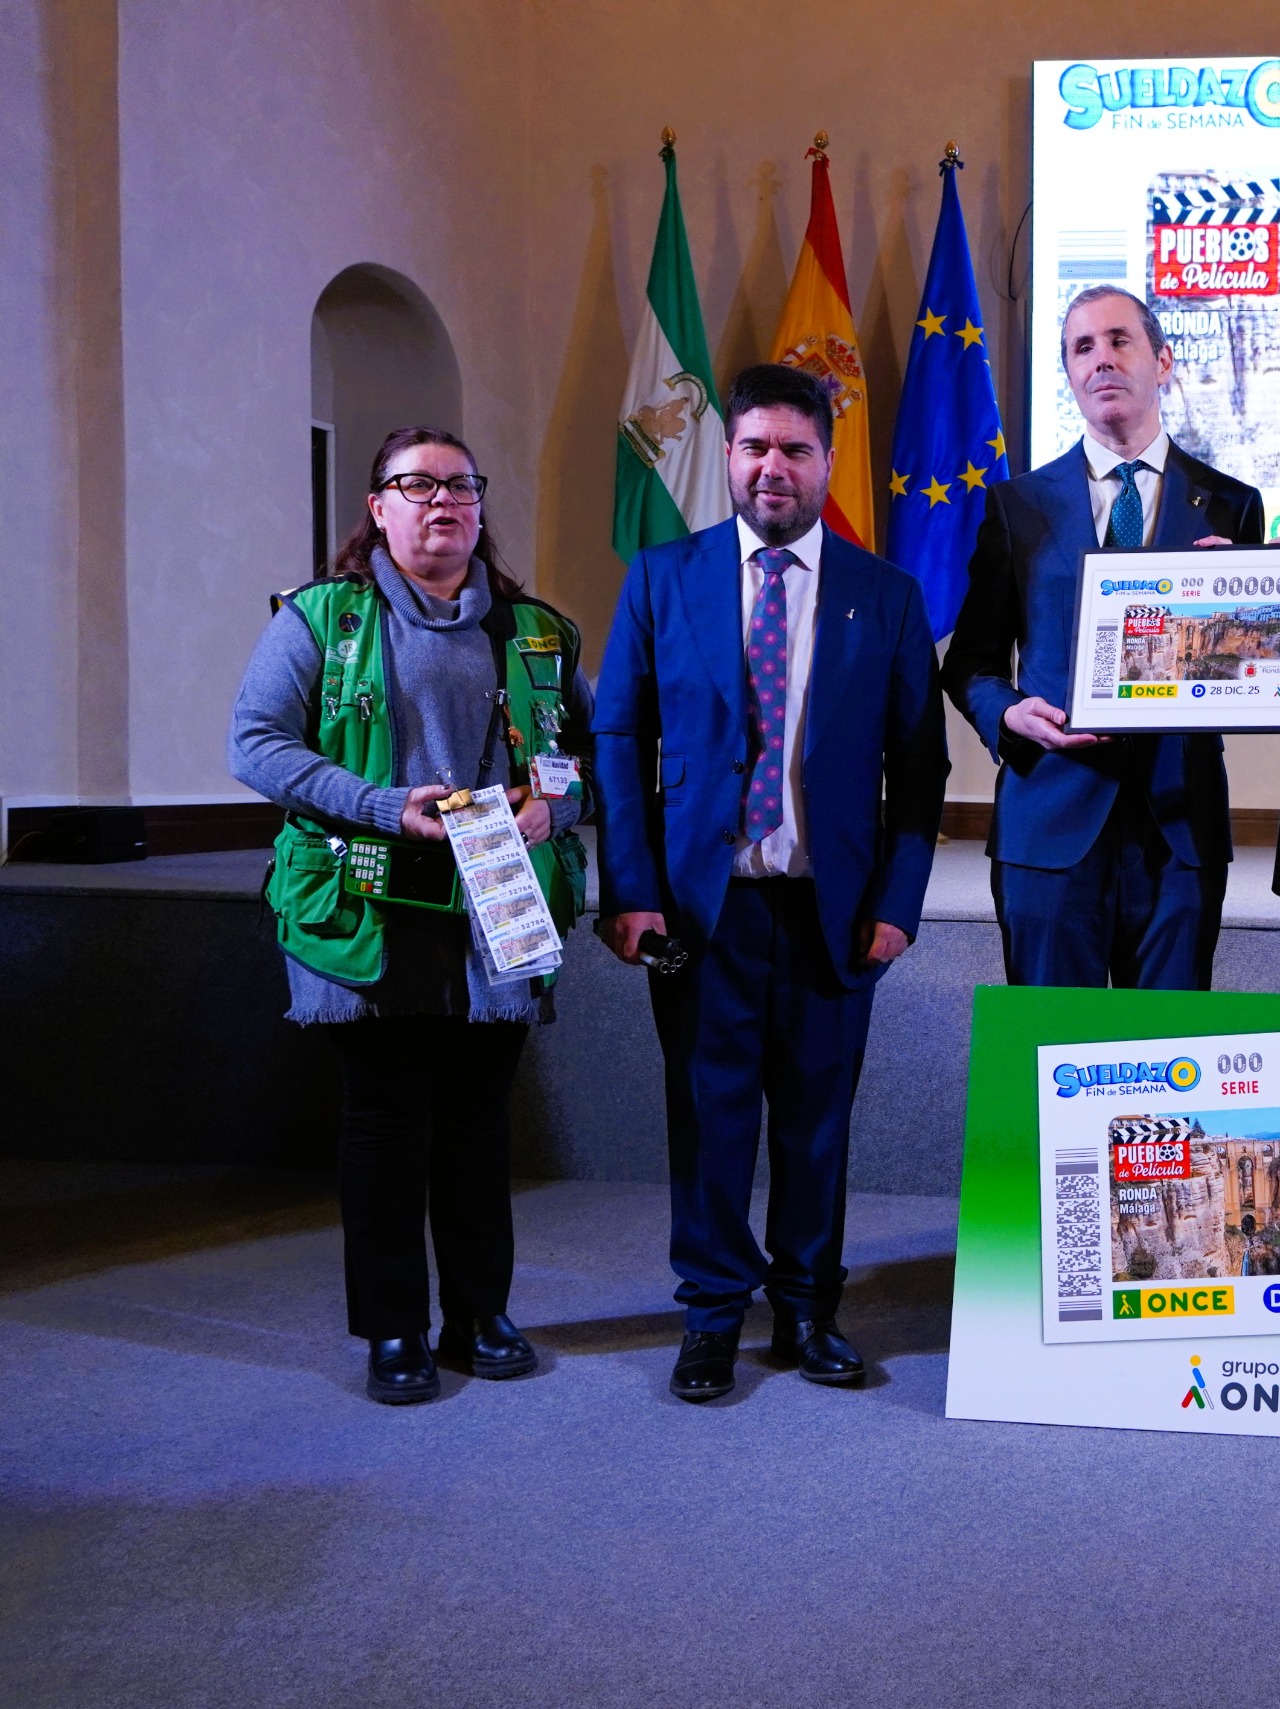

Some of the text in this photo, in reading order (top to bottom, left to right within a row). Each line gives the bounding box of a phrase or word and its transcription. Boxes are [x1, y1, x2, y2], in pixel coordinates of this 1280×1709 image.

[1167, 113, 1244, 129] SEMANA
[1160, 227, 1270, 264] PUEBLOS
[1160, 263, 1269, 289] de Película
[1159, 311, 1222, 335] RONDA
[1170, 340, 1219, 364] álaga
[1100, 578, 1174, 596] SUELDAZO
[1181, 577, 1204, 587] 000
[531, 638, 559, 649] ONC
[1135, 686, 1175, 697] ONCE
[1210, 685, 1260, 695] 28 DIC. 25
[1217, 1052, 1263, 1074] 000
[1053, 1057, 1201, 1098] SUELDAZO
[1119, 1085, 1166, 1096] SEMANA
[1221, 1080, 1259, 1096] SERIE
[1118, 1143, 1184, 1164] PUEBLOS
[1118, 1161, 1185, 1178] de Película
[1120, 1188, 1157, 1201] RONDA
[1120, 1203, 1156, 1214] Málaga
[1147, 1290, 1228, 1313] ONCE
[1222, 1361, 1279, 1378] grupo
